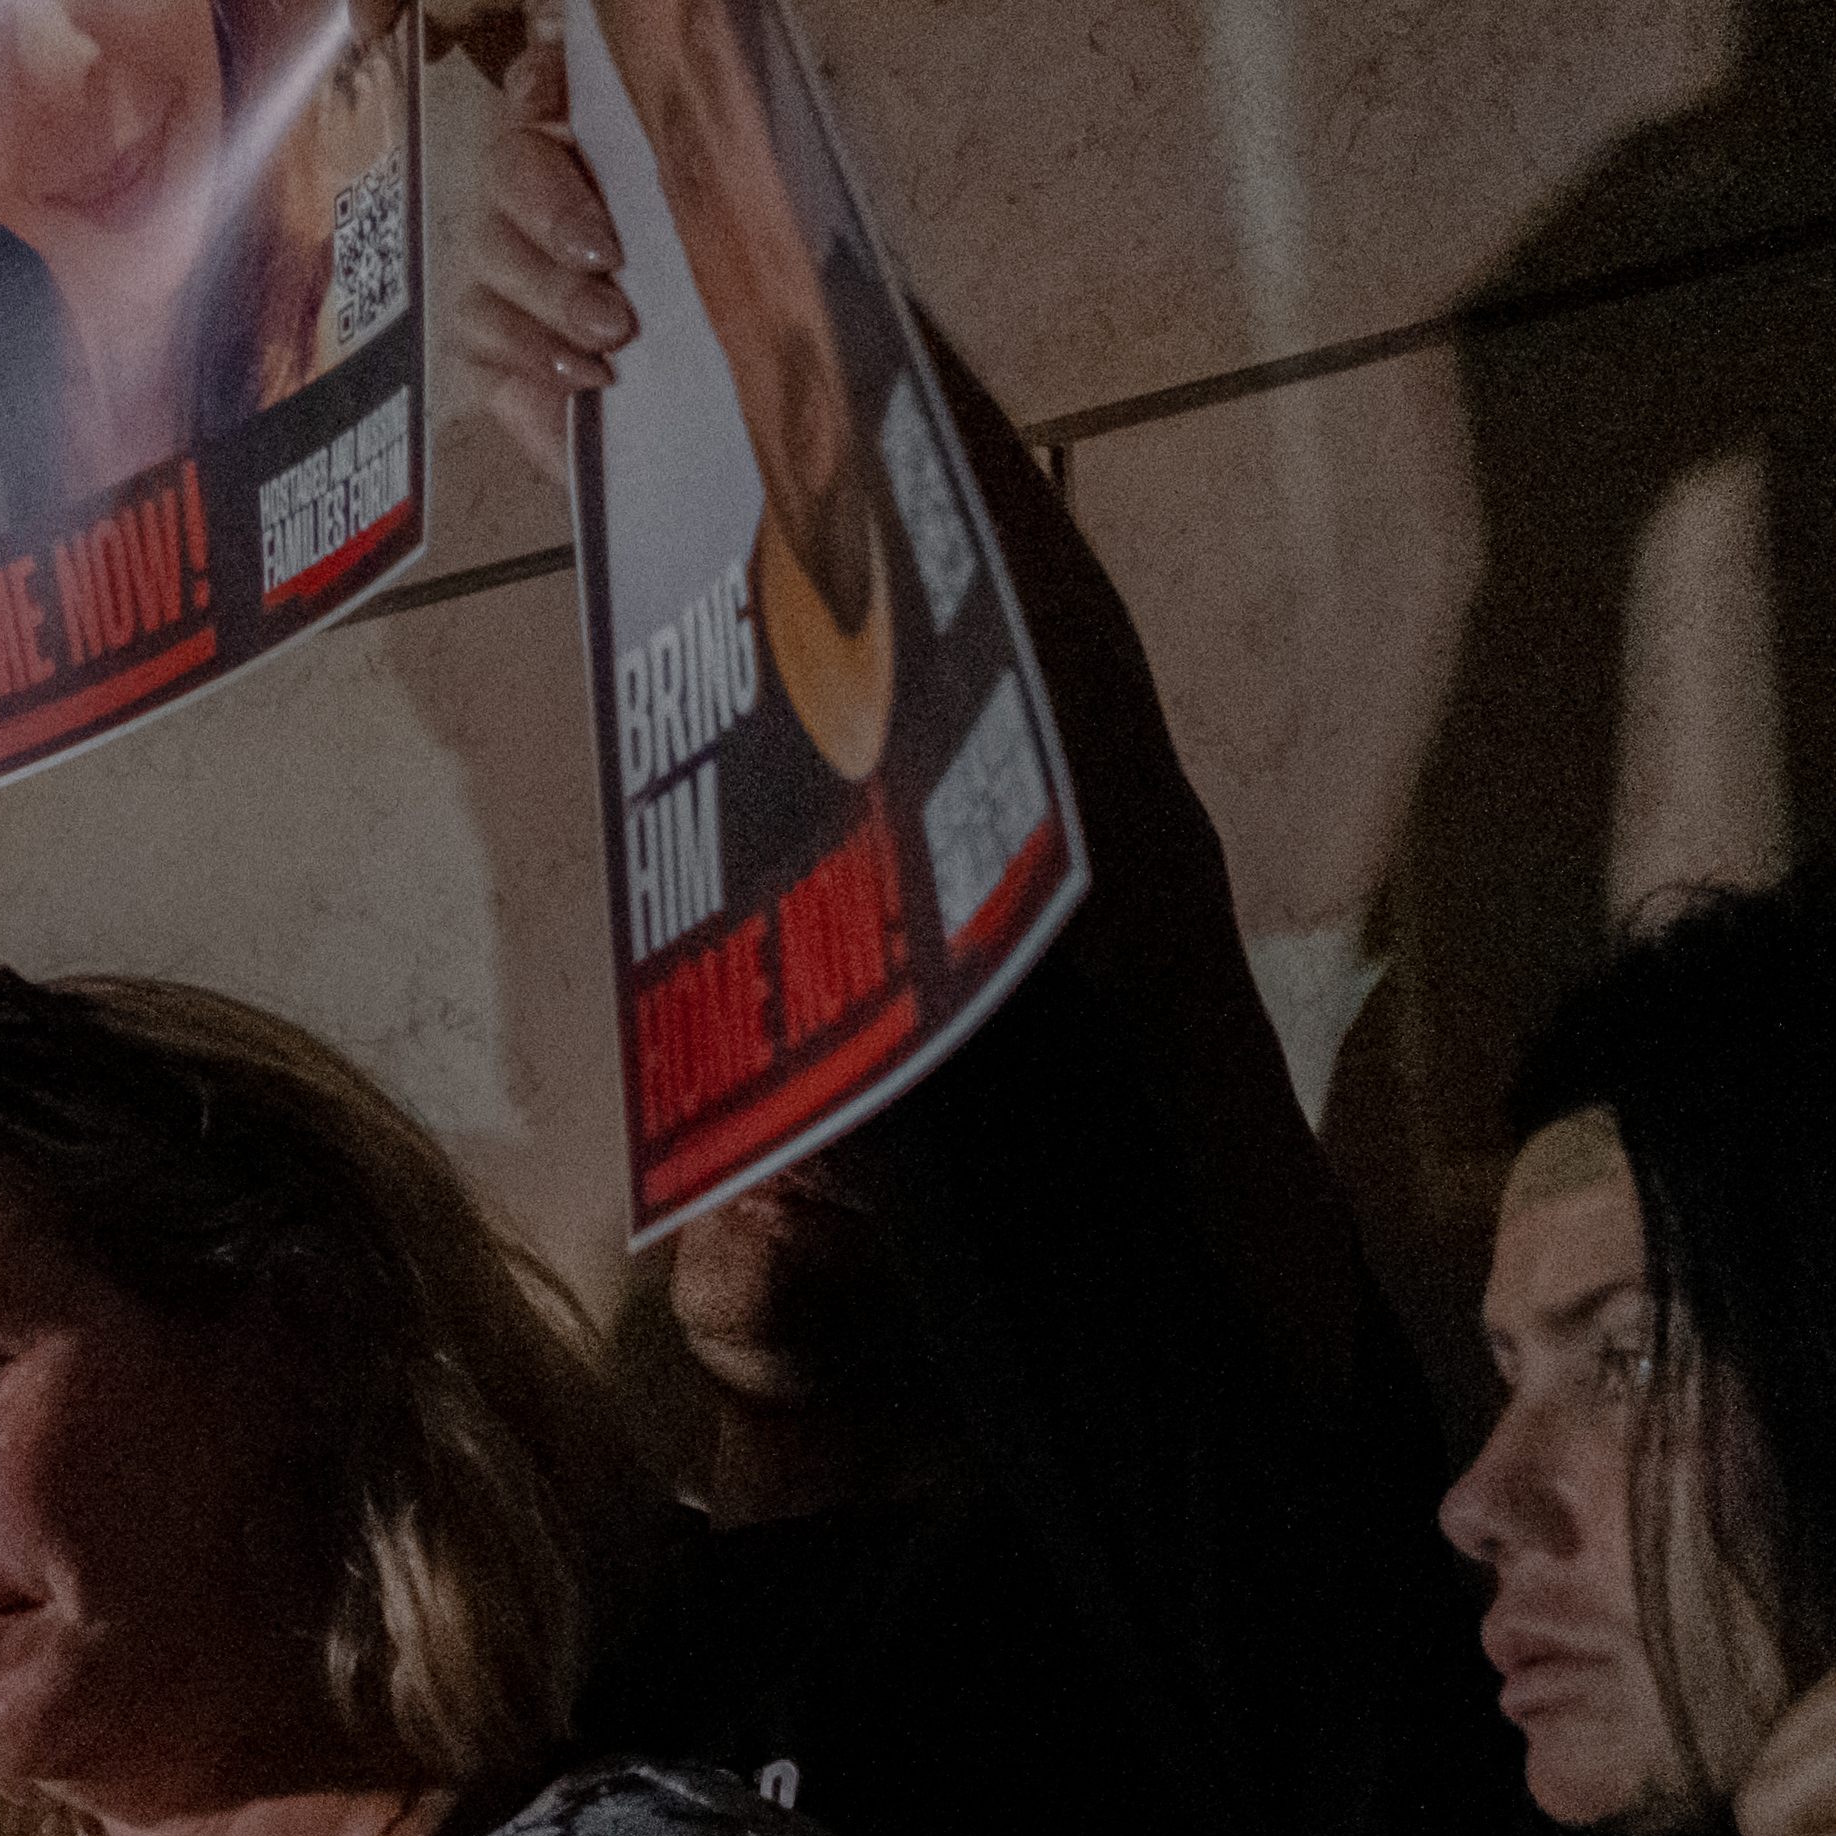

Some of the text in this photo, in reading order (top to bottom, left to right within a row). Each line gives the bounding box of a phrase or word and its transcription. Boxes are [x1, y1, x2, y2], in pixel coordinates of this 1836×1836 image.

[55, 458, 210, 667] NOW!
[263, 482, 346, 593] FAMILIES
[616, 560, 758, 798] BRING
[628, 758, 725, 964] HIM
